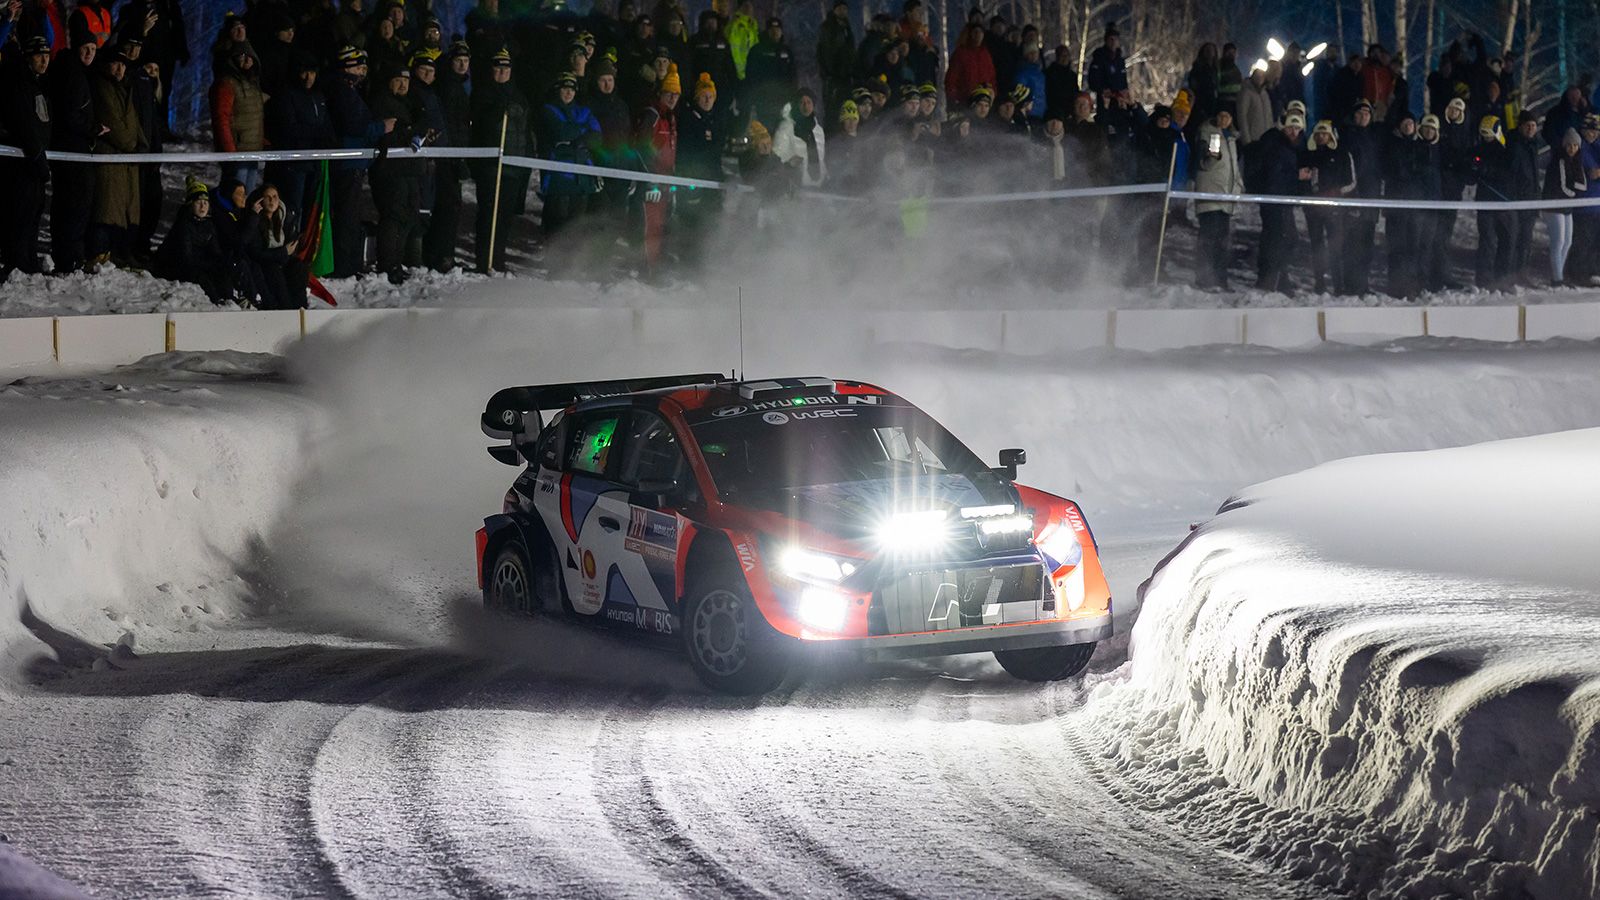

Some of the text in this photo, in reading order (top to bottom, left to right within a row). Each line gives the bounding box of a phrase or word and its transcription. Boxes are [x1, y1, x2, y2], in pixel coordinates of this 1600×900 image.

[791, 409, 857, 419] WRC
[1064, 506, 1085, 532] WIA
[736, 543, 755, 572] WIA
[607, 607, 672, 634] HYUNDAI MBIS
